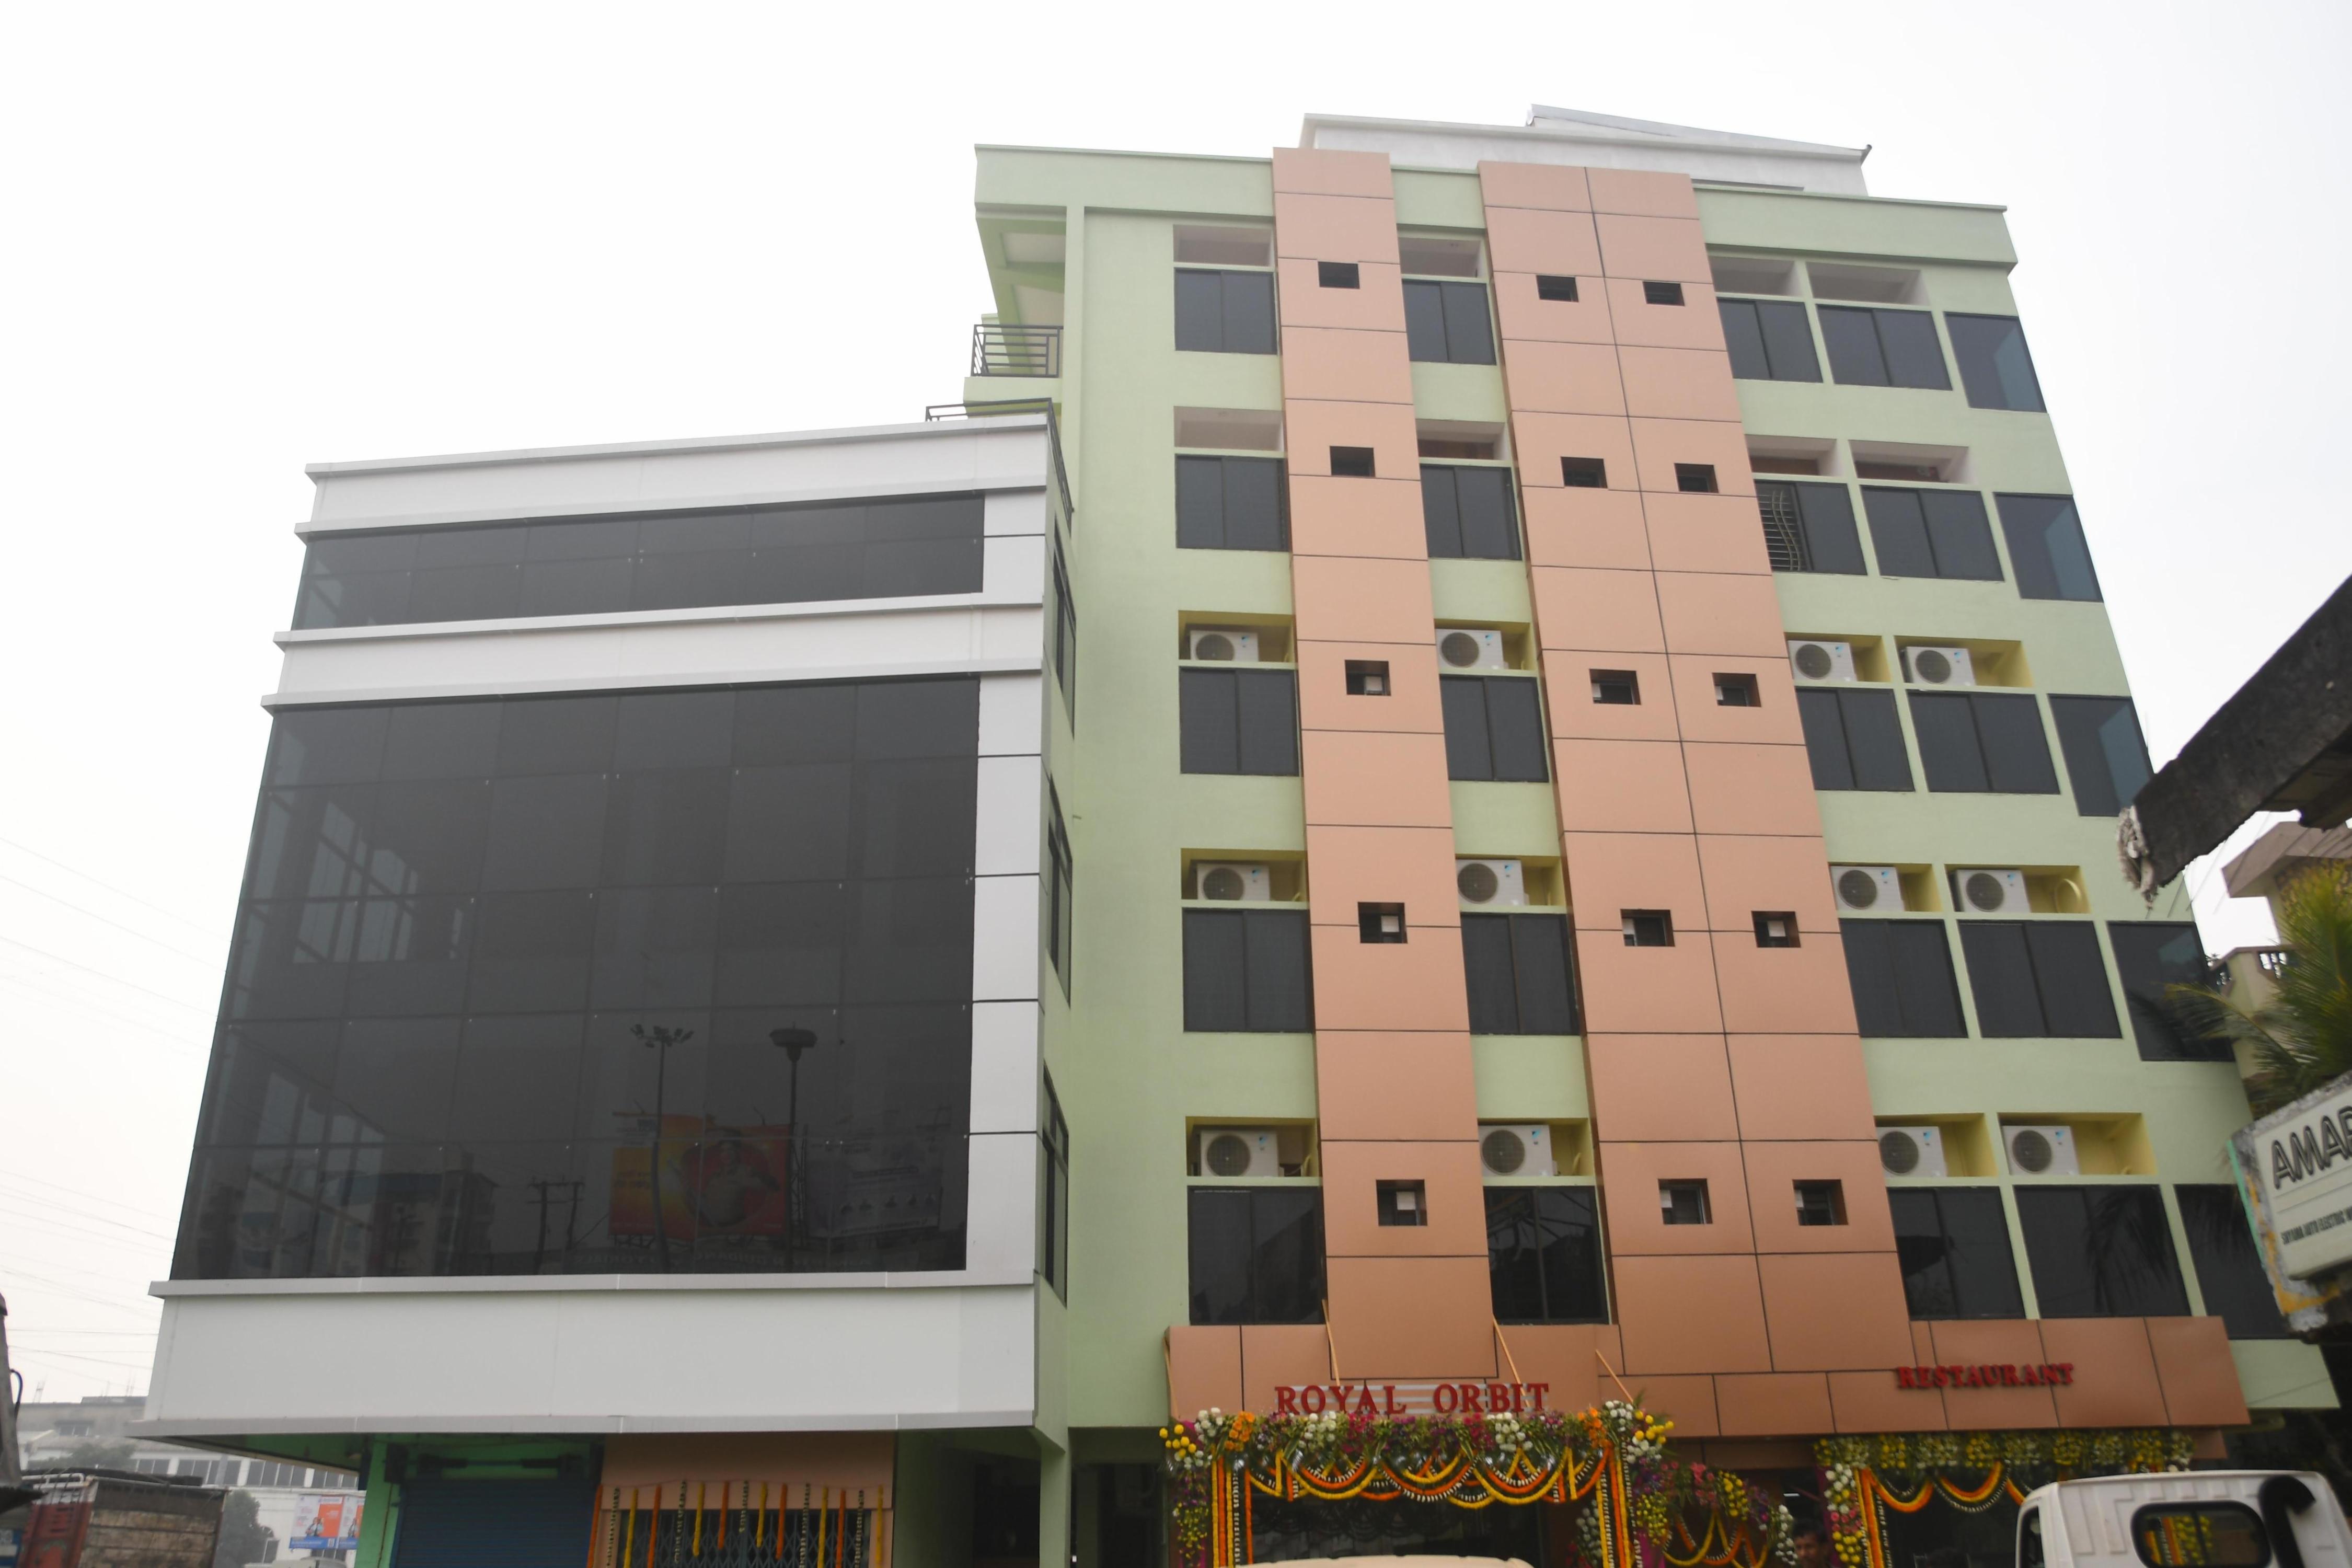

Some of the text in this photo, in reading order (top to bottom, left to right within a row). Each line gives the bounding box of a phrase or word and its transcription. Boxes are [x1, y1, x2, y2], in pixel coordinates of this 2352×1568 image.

[1897, 1363, 2073, 1388] RESTAURANT
[1275, 1383, 1549, 1414] ROYAL ORBIT
